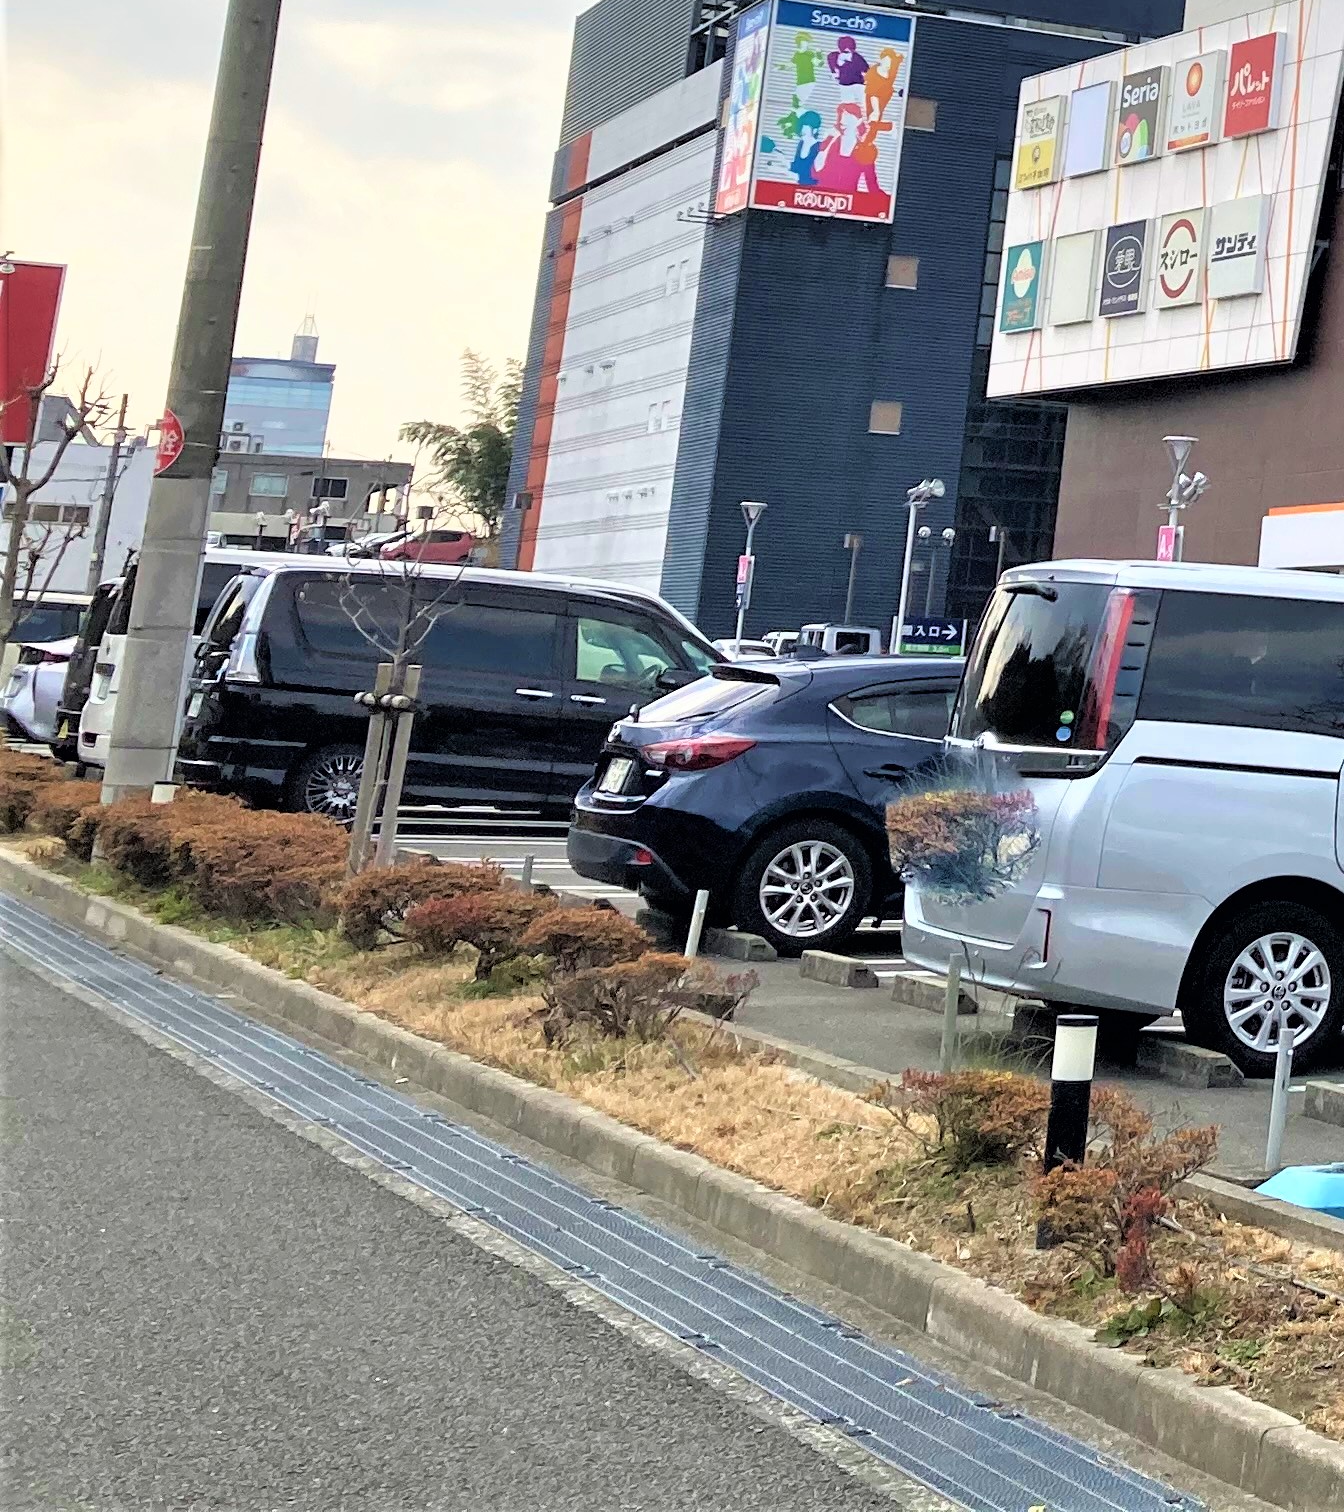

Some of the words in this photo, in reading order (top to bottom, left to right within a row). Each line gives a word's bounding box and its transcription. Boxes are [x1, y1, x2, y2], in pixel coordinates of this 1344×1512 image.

[1122, 76, 1160, 109] Seria
[1160, 248, 1198, 271] スシロー
